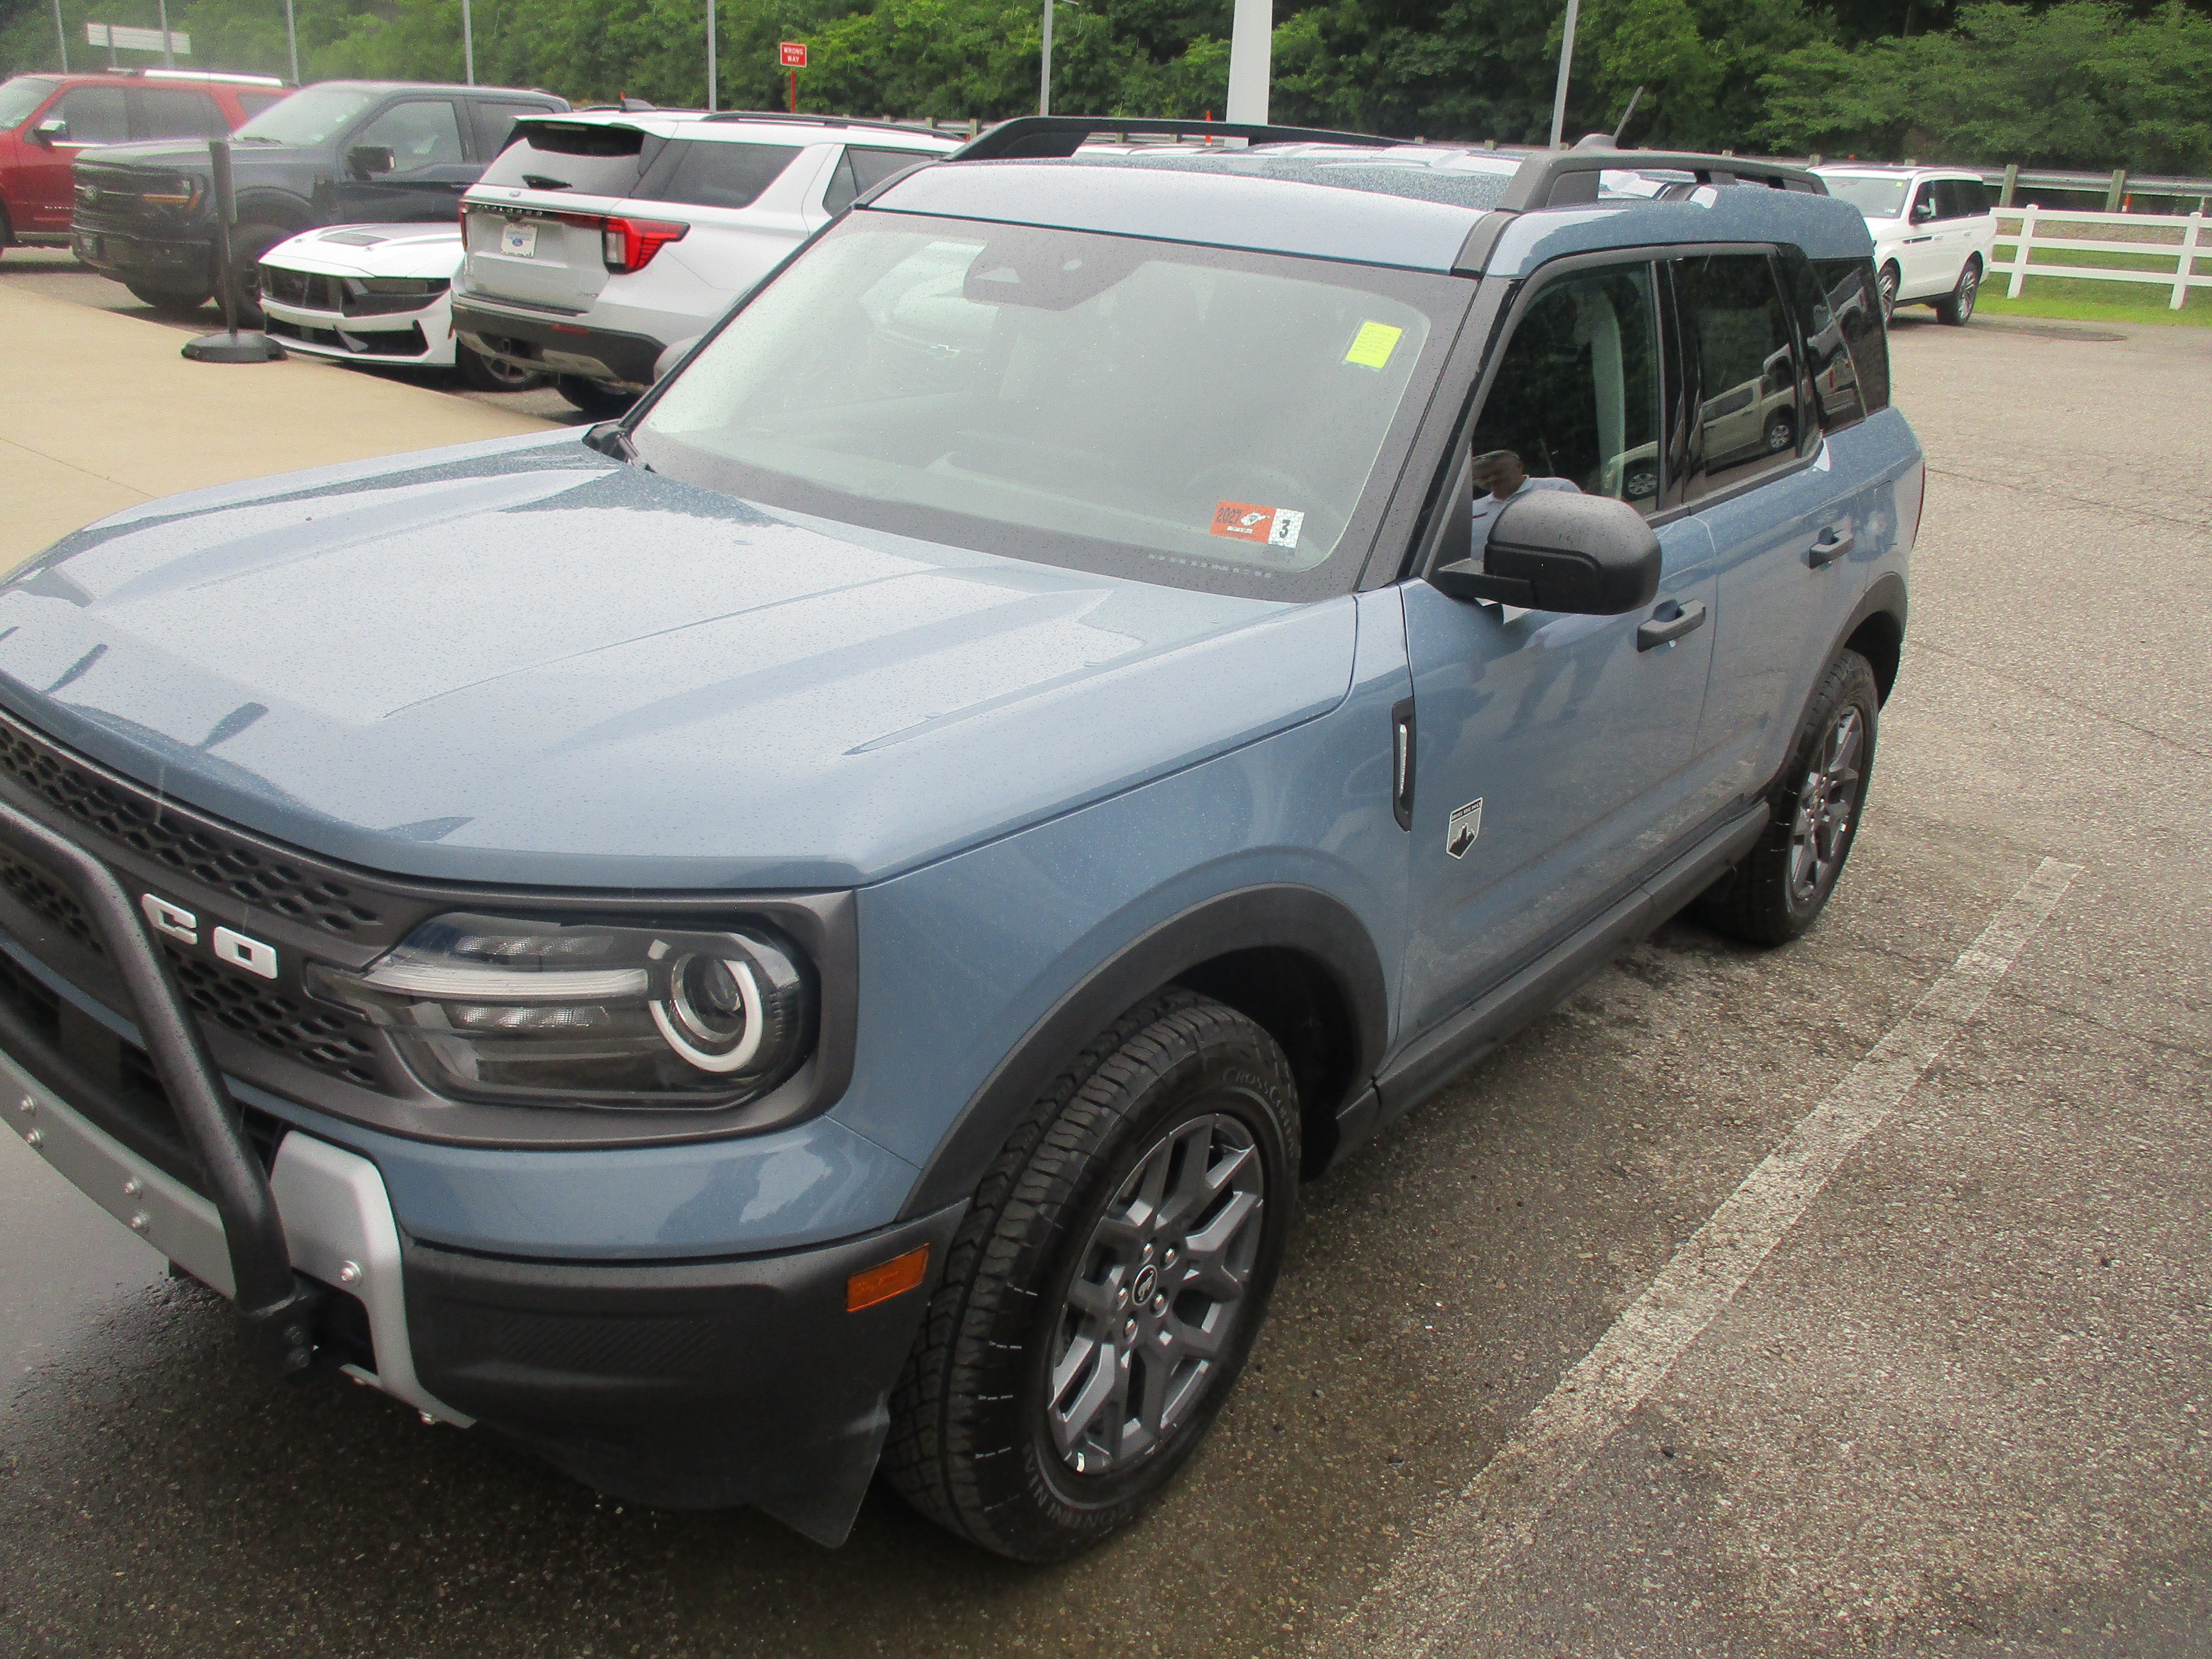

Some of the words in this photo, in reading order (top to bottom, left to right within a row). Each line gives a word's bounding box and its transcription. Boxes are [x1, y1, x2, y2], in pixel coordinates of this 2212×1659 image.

[784, 47, 803, 55] WRONG
[1216, 507, 1243, 525] 2027
[1279, 519, 1291, 538] 3
[1452, 811, 1462, 820] BIG
[1463, 802, 1481, 814] BEND
